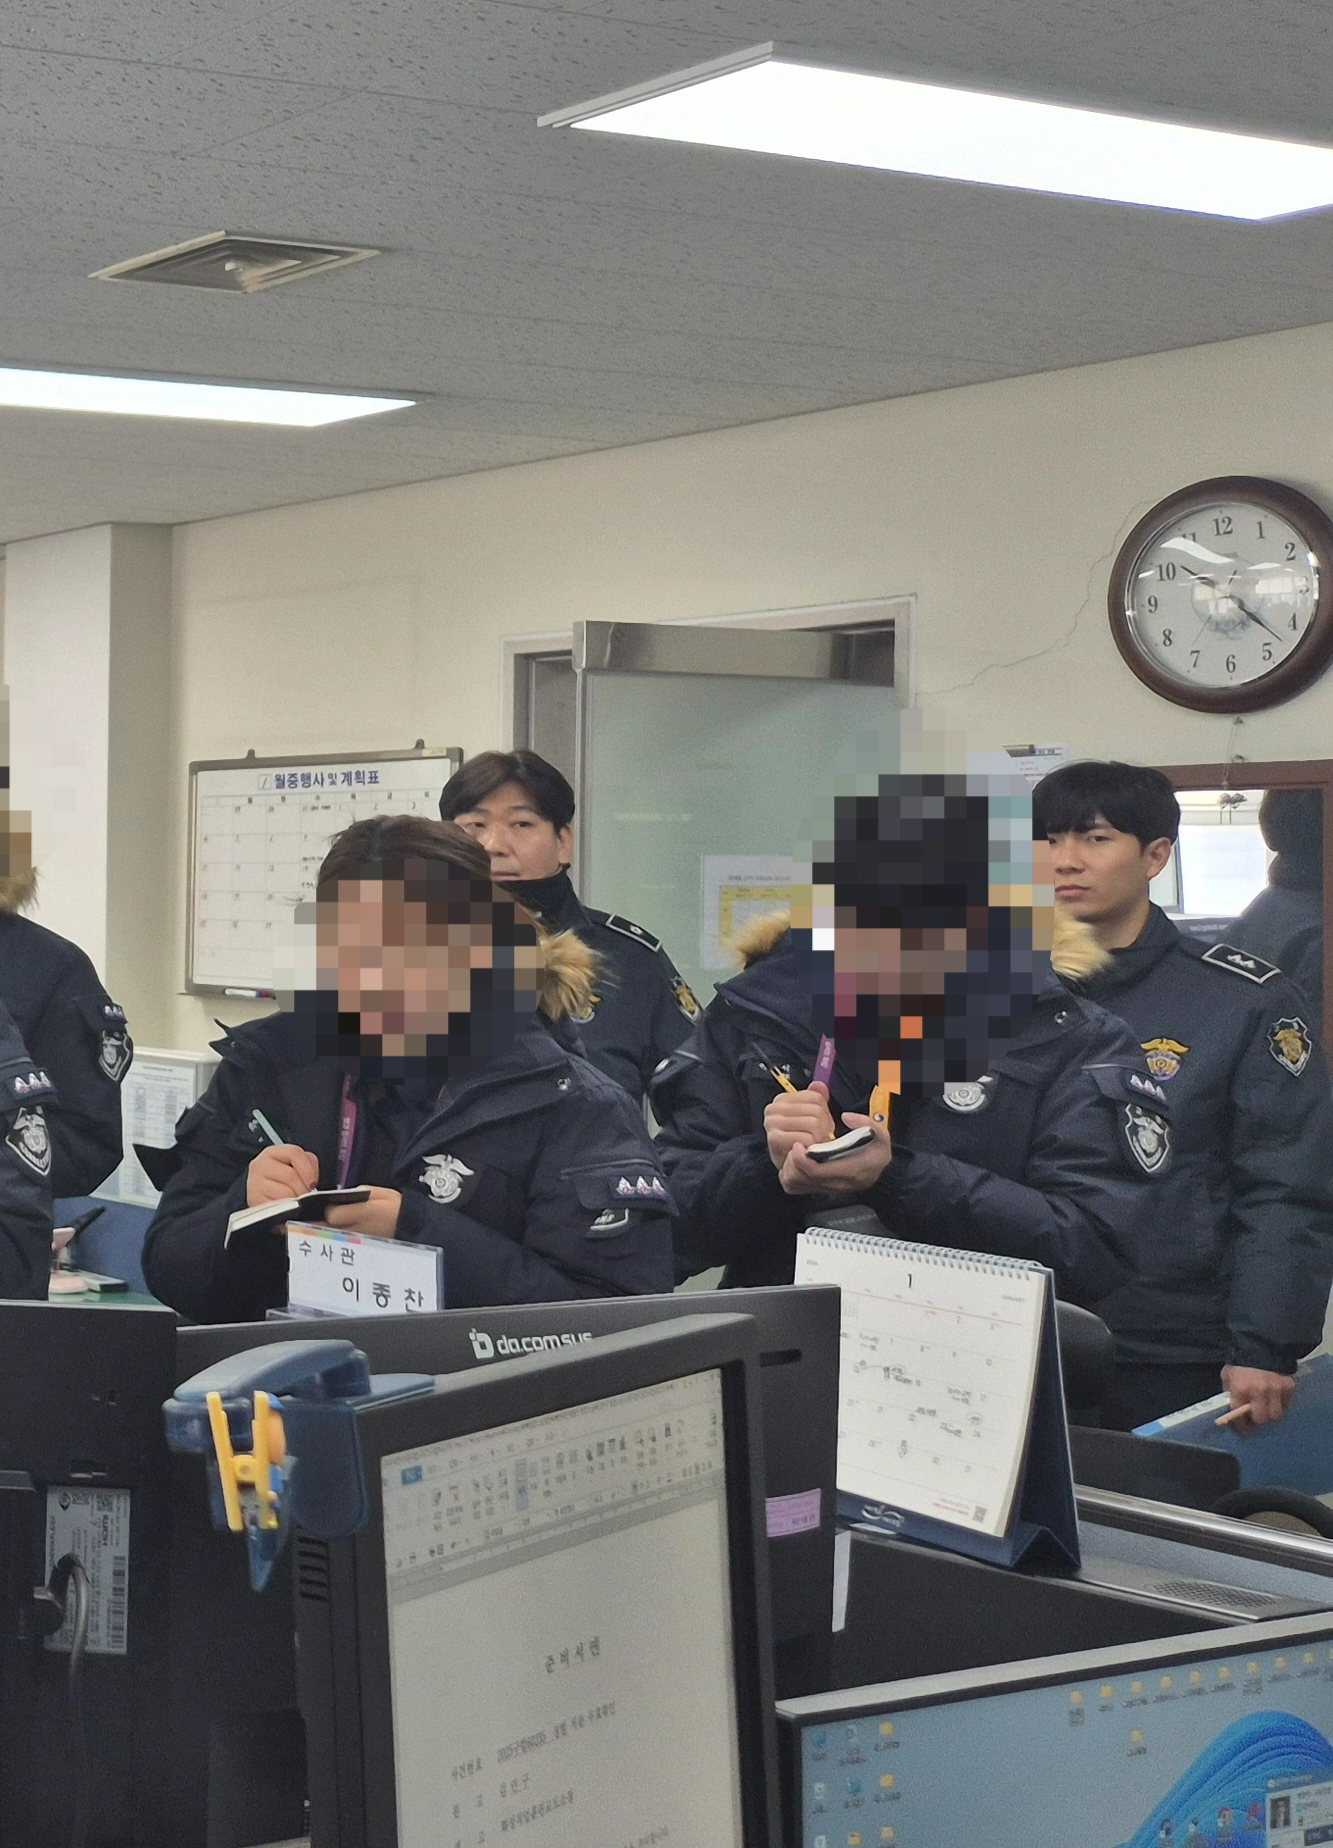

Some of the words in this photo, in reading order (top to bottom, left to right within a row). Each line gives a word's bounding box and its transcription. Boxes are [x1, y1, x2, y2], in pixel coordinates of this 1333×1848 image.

[1213, 516, 1233, 536] 12
[1257, 521, 1265, 539] 1
[1285, 542, 1296, 561] 2
[1157, 562, 1176, 581] 10
[1299, 576, 1310, 595] 3
[1148, 596, 1158, 613] 9
[1288, 613, 1297, 631] 4
[1162, 628, 1173, 647] 8
[1190, 650, 1201, 668] 7
[1262, 643, 1272, 660] 5
[1226, 655, 1236, 673] 6
[274, 772, 325, 789] 월중행사
[327, 774, 337, 786] 및
[340, 770, 380, 786] 계획표
[298, 1240, 355, 1266] 수사관
[907, 1273, 913, 1288] 1
[342, 1277, 424, 1312] 이종찬
[545, 1636, 601, 1674] 준비서면
